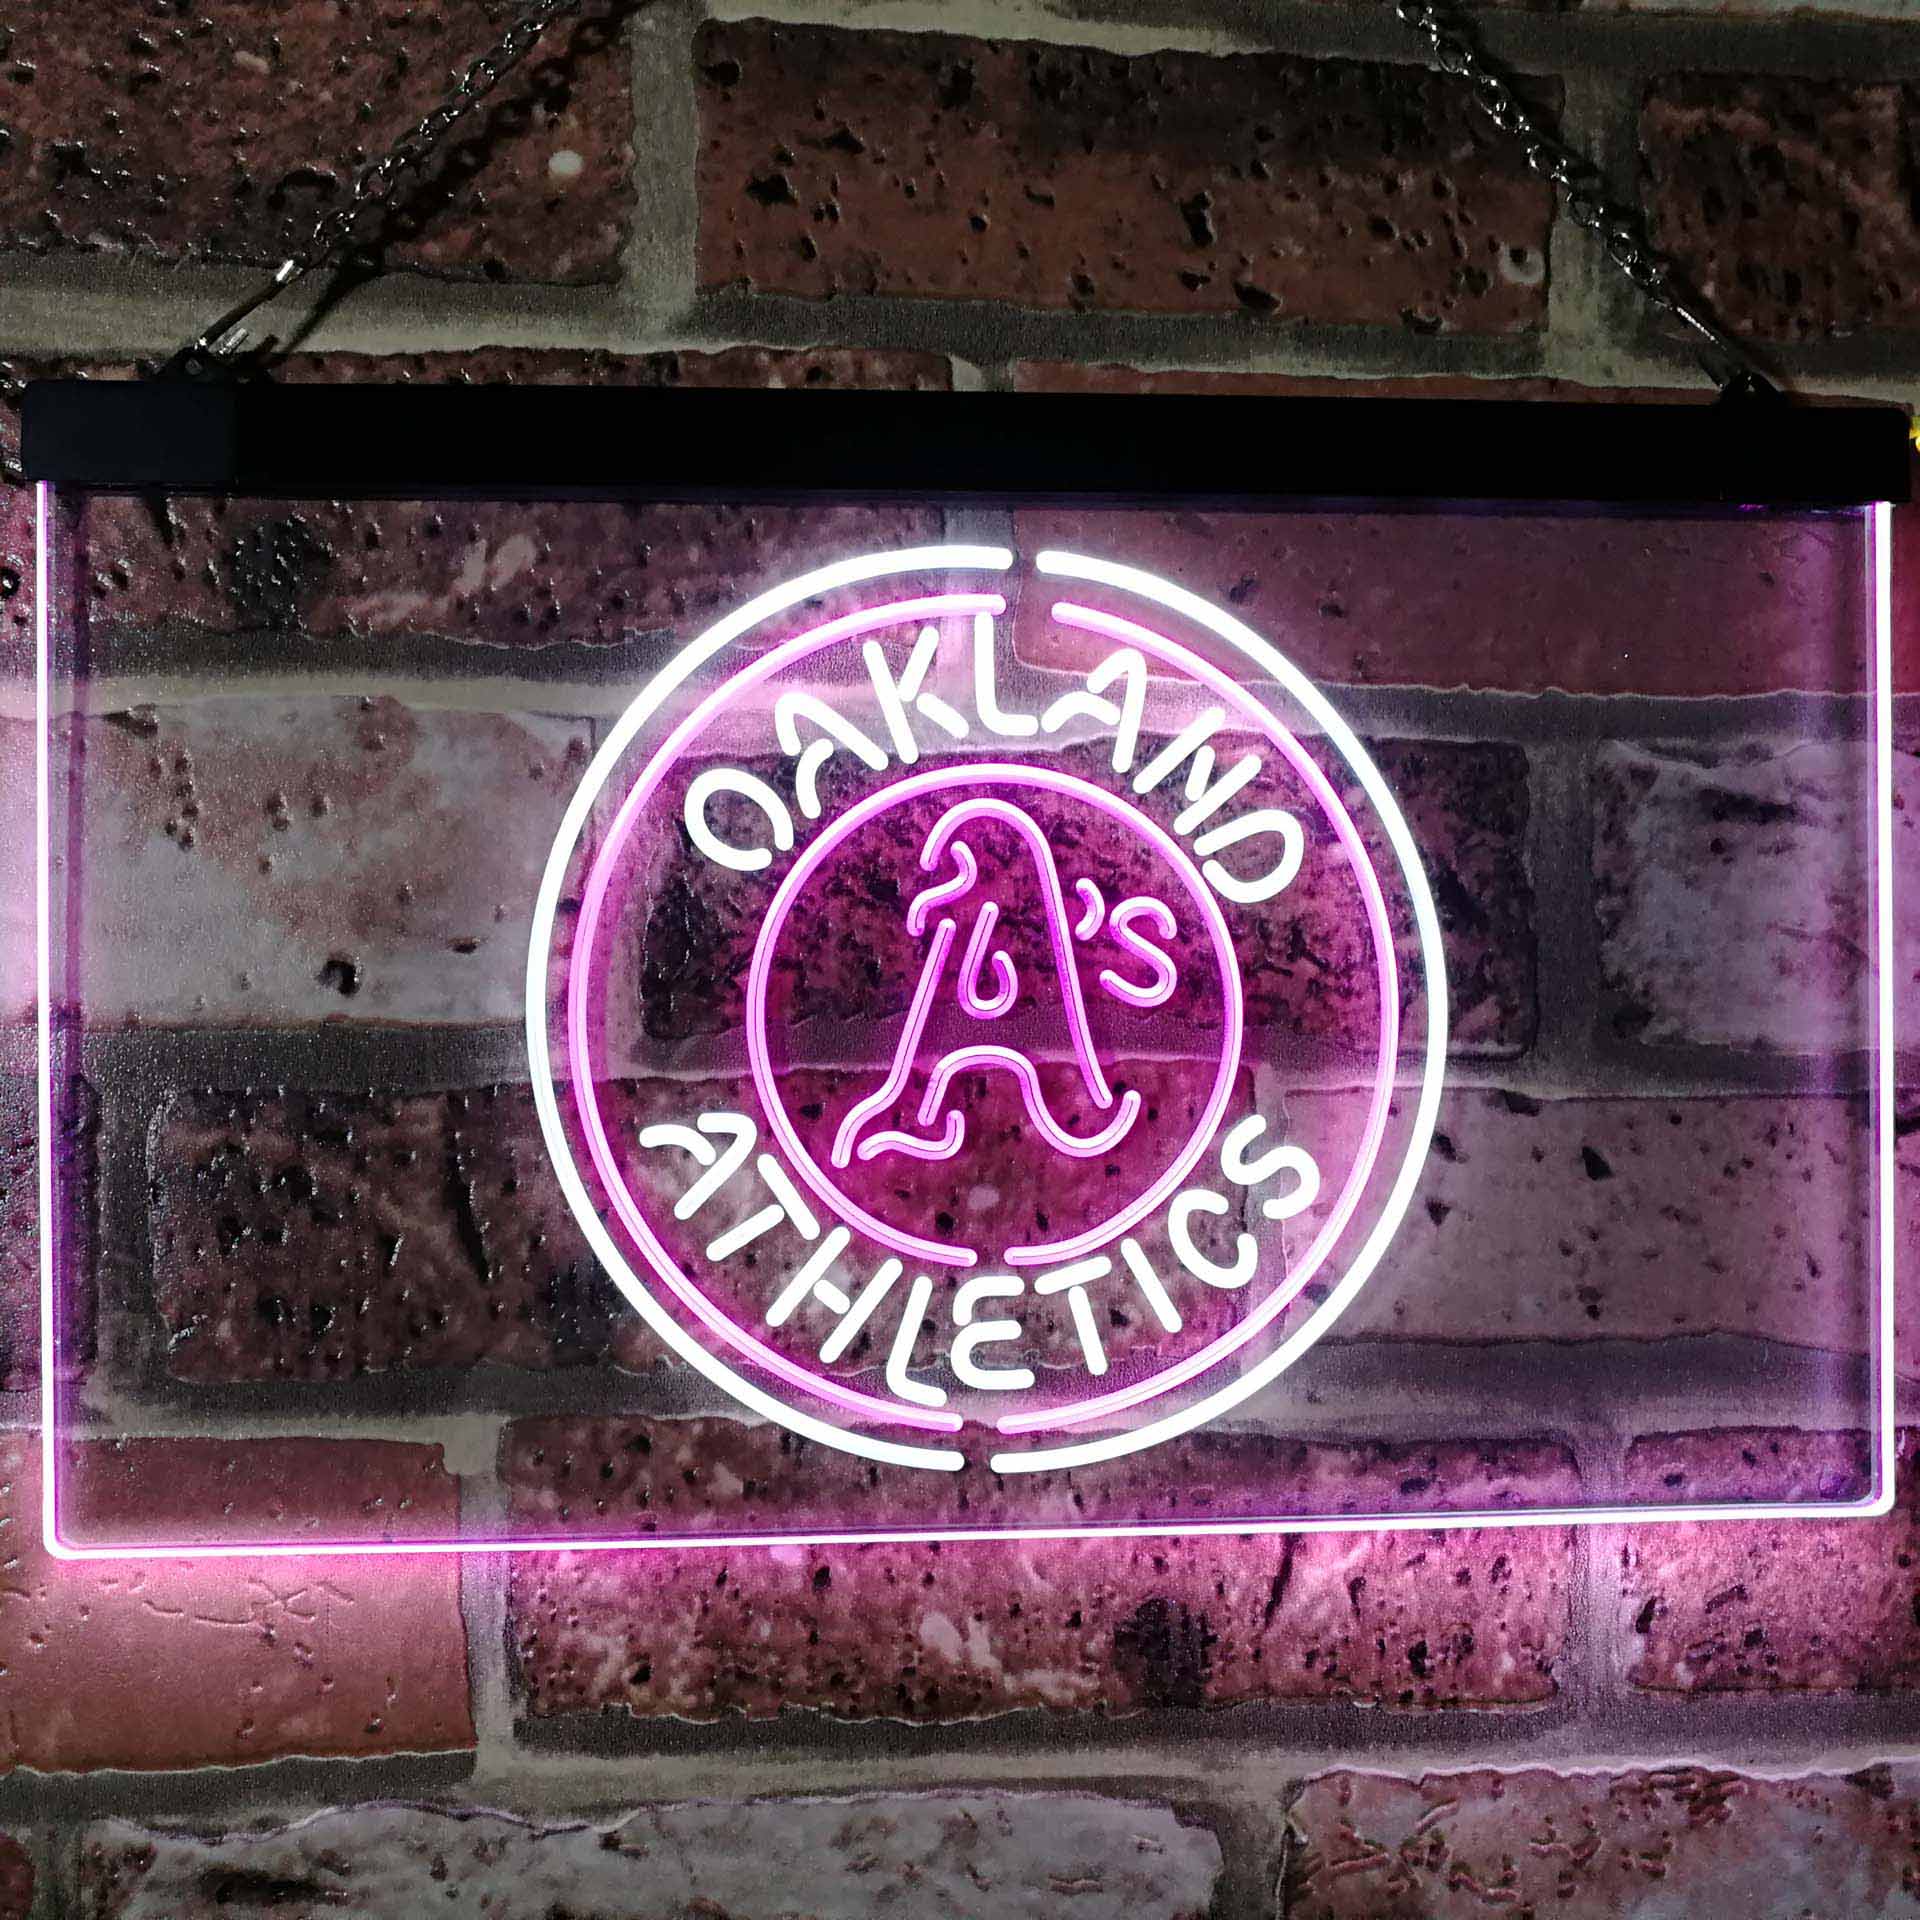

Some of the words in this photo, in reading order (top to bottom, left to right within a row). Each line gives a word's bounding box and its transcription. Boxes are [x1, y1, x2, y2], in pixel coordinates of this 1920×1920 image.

[684, 612, 1304, 903] OAKLAND
[831, 798, 1177, 1168] A's
[639, 1112, 1321, 1407] ATHLETICS
